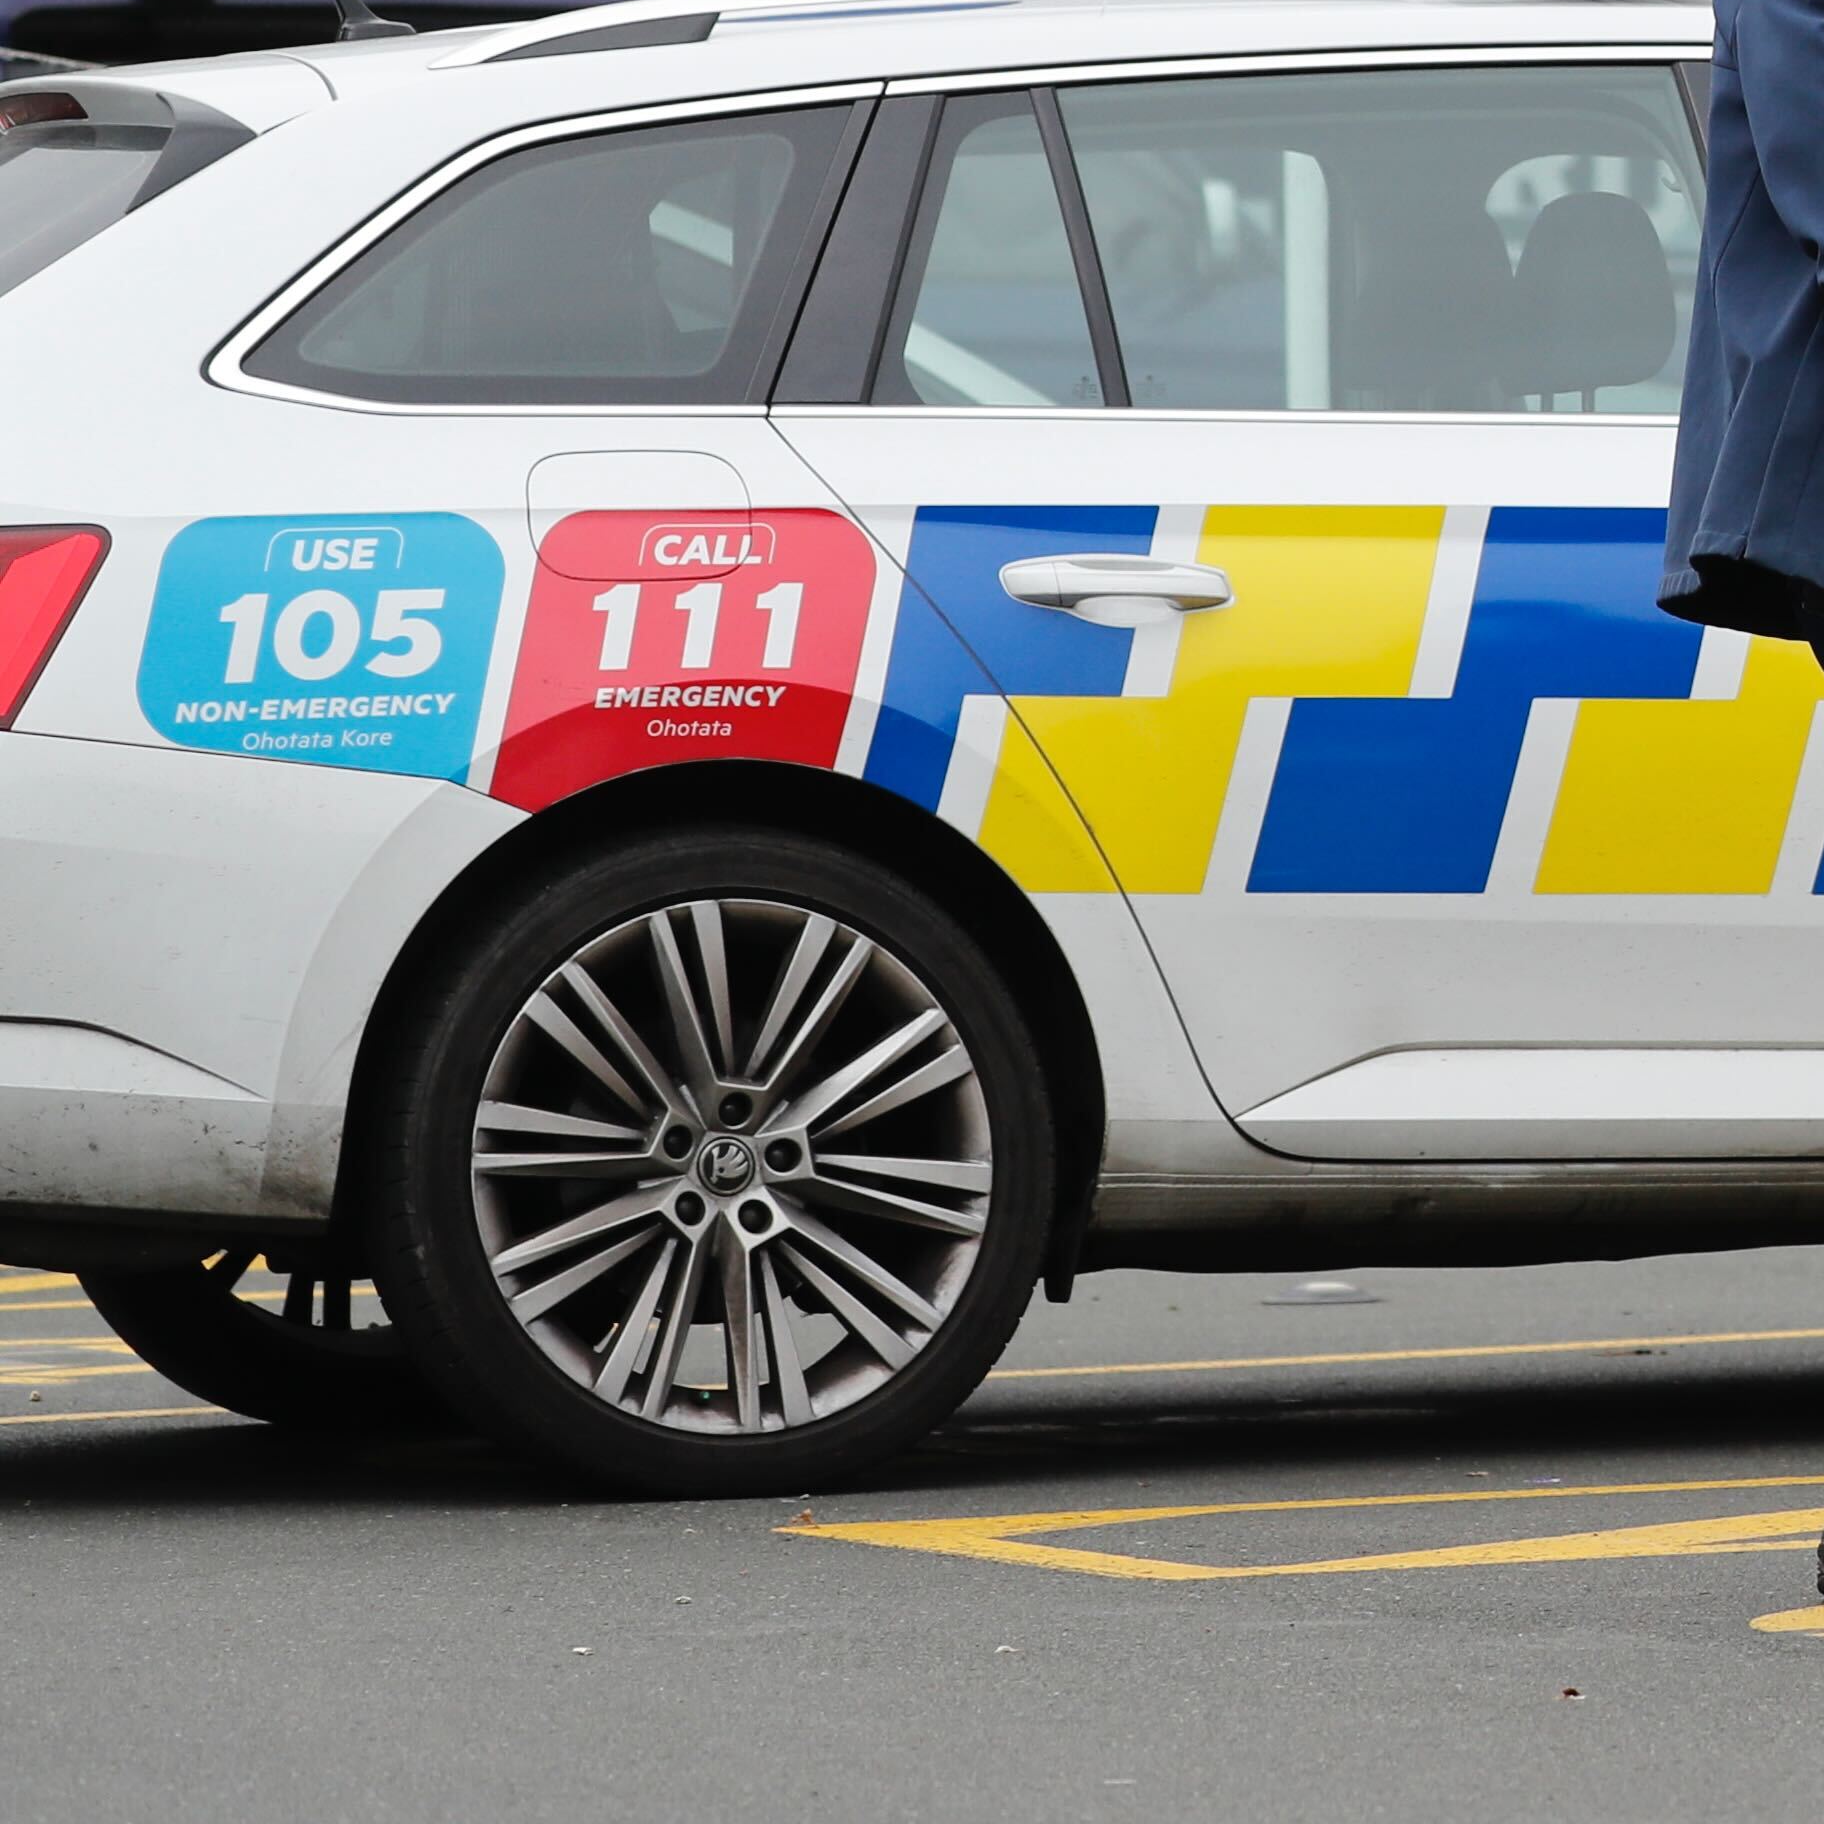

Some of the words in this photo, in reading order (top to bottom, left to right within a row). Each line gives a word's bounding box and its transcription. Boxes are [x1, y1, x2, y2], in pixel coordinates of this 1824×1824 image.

[290, 536, 381, 573] USE
[653, 534, 763, 566] CALL
[218, 587, 448, 684] 105
[591, 582, 804, 671] 111
[175, 692, 456, 724] NON-EMERGENCY
[594, 686, 786, 709] EMERGENCY
[242, 732, 333, 750] Ohotata
[341, 730, 393, 746] Kore
[647, 719, 732, 737] Ohotata
